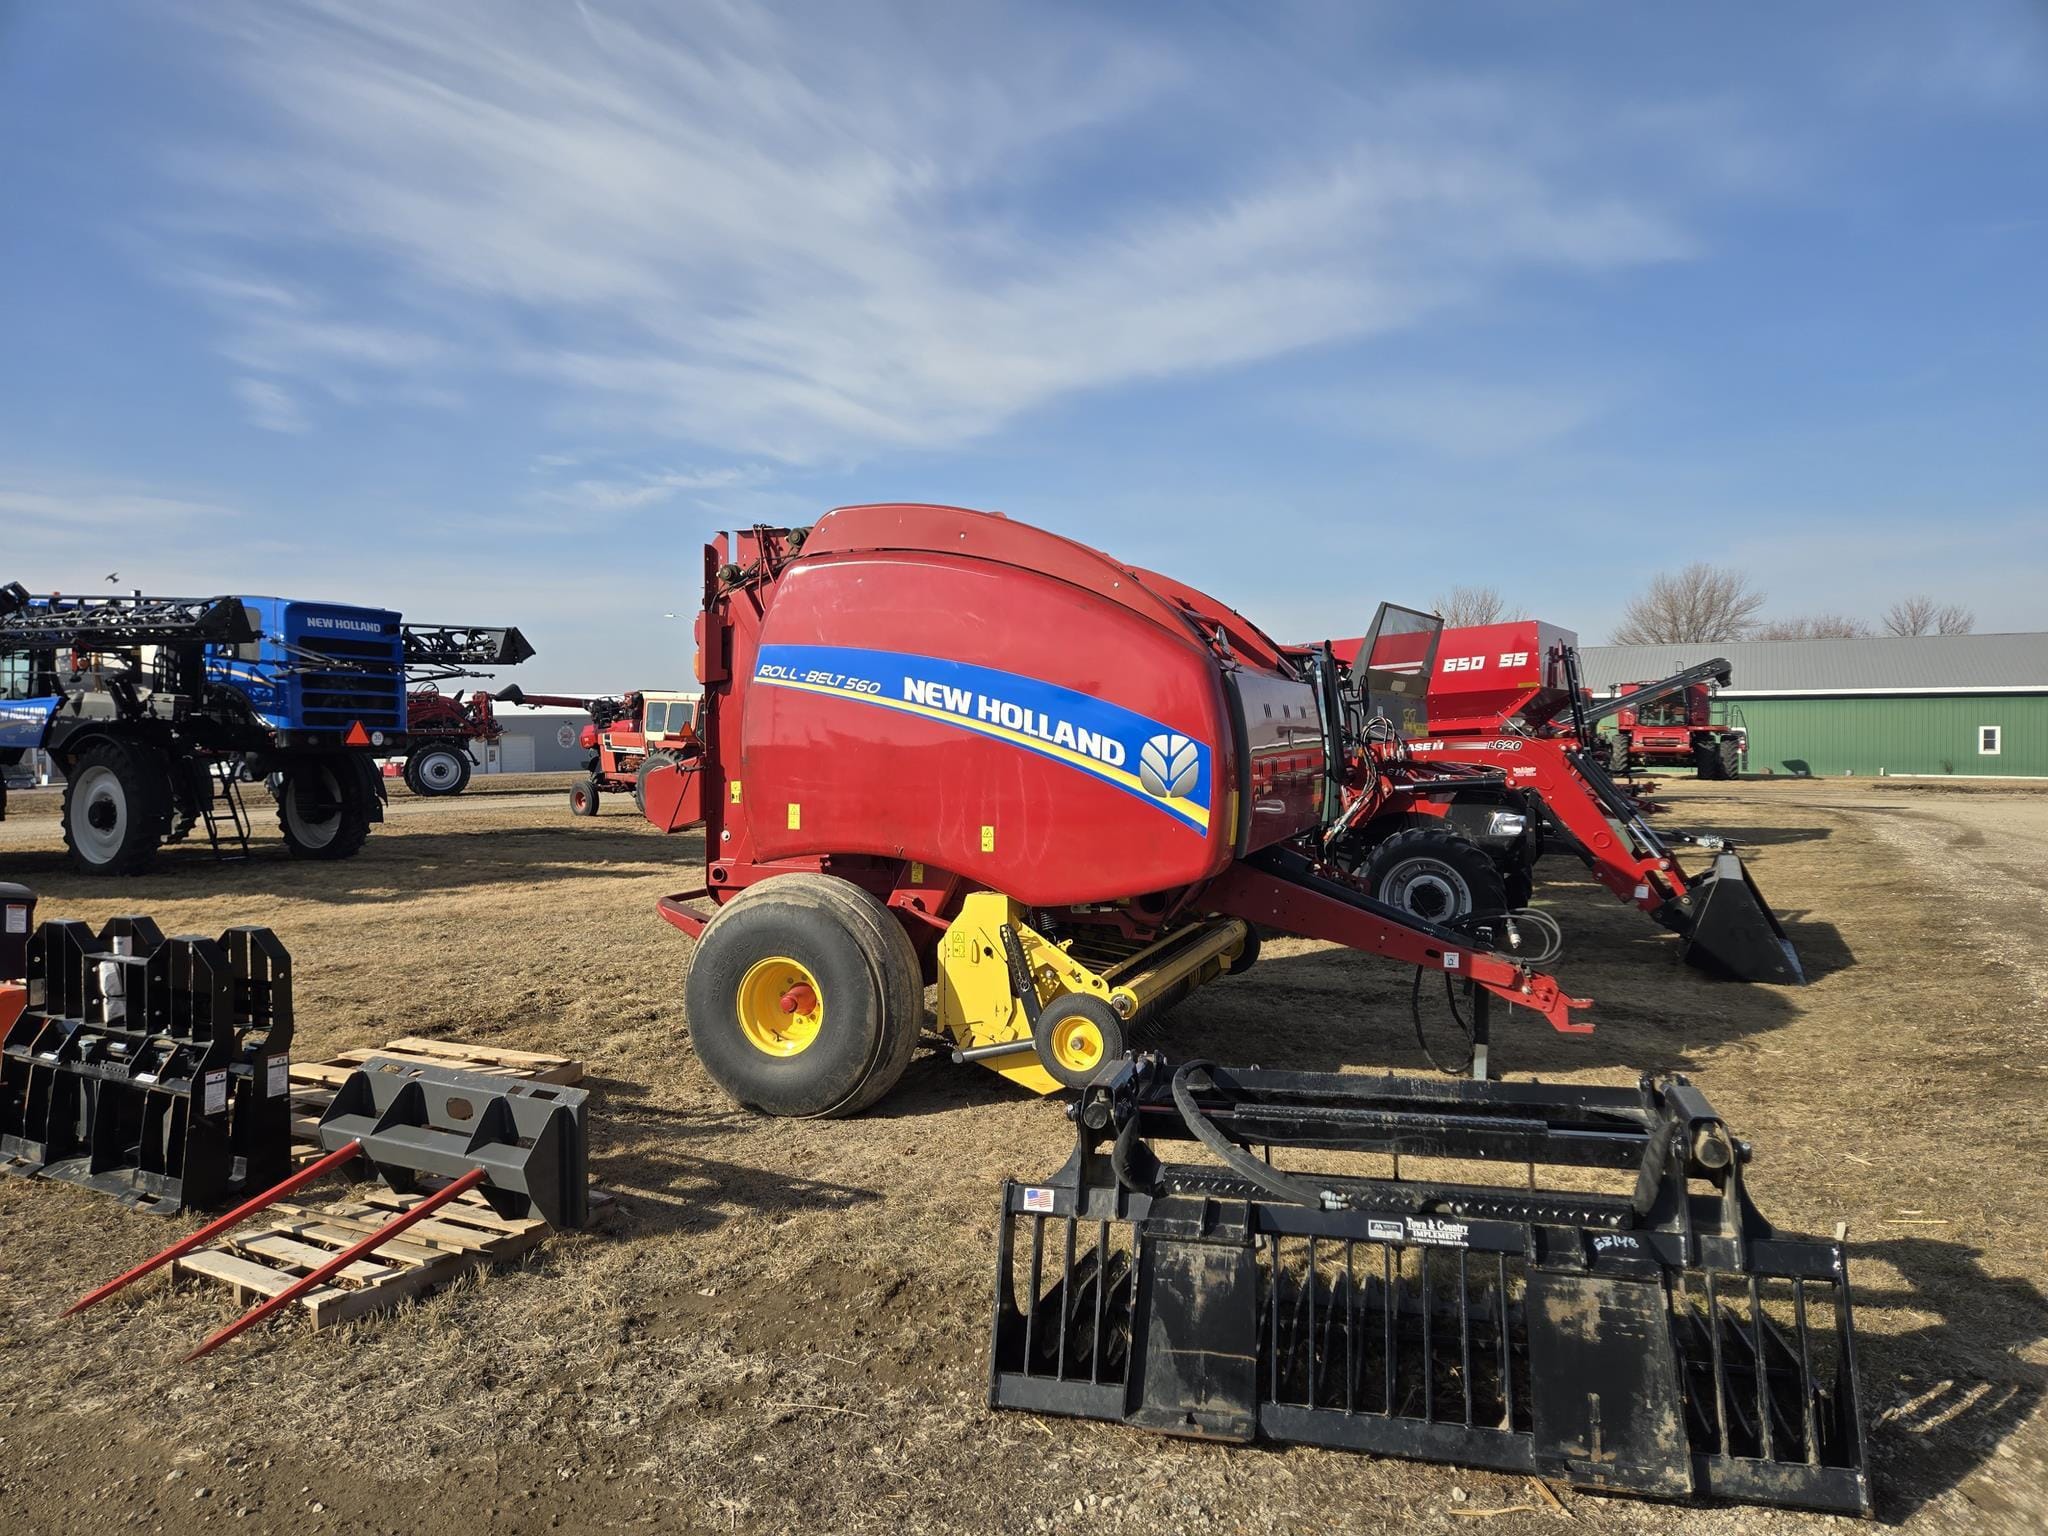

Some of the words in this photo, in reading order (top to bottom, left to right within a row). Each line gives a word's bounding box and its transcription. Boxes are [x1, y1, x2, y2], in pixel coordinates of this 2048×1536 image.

[306, 617, 333, 628] NEW
[335, 619, 381, 633] HOLLAND
[1442, 655, 1486, 672] 650
[758, 664, 845, 687] ROLL-BELT
[844, 677, 881, 694] 560
[903, 676, 972, 715] NEW
[977, 694, 1126, 767] HOLLAND
[1407, 743, 1432, 752] ASE
[1487, 739, 1522, 751] L620
[1405, 1216, 1427, 1230] Town
[1428, 1218, 1436, 1231] &
[1437, 1220, 1469, 1234] Country
[1413, 1230, 1462, 1241] IMPLEMENT
